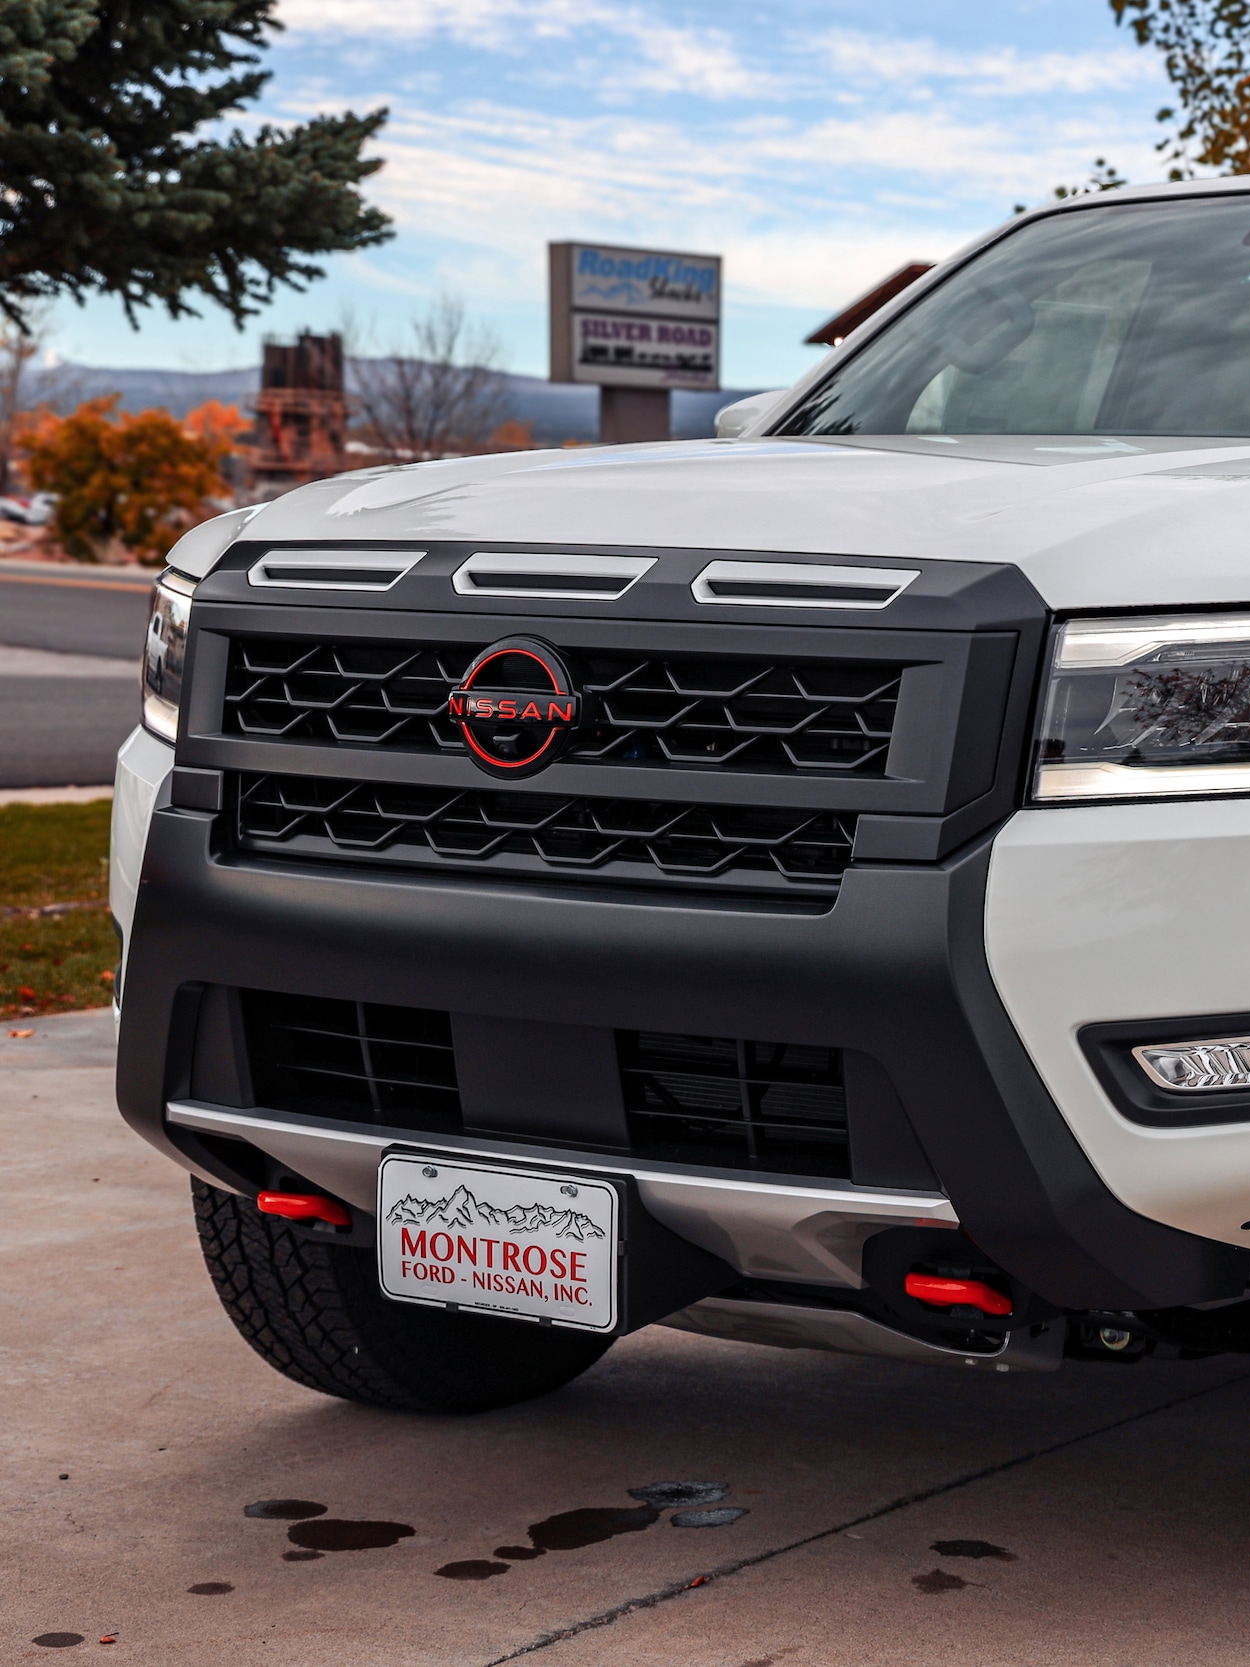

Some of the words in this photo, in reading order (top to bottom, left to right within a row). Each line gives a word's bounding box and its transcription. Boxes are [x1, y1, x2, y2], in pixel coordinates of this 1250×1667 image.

[580, 318, 653, 343] SILVER
[657, 323, 712, 347] ROAD
[449, 696, 573, 722] NISSAN
[401, 1227, 588, 1283] MONTROSE
[401, 1260, 456, 1284] FORD
[472, 1271, 549, 1303] NISSAN,
[553, 1283, 593, 1307] INC.
